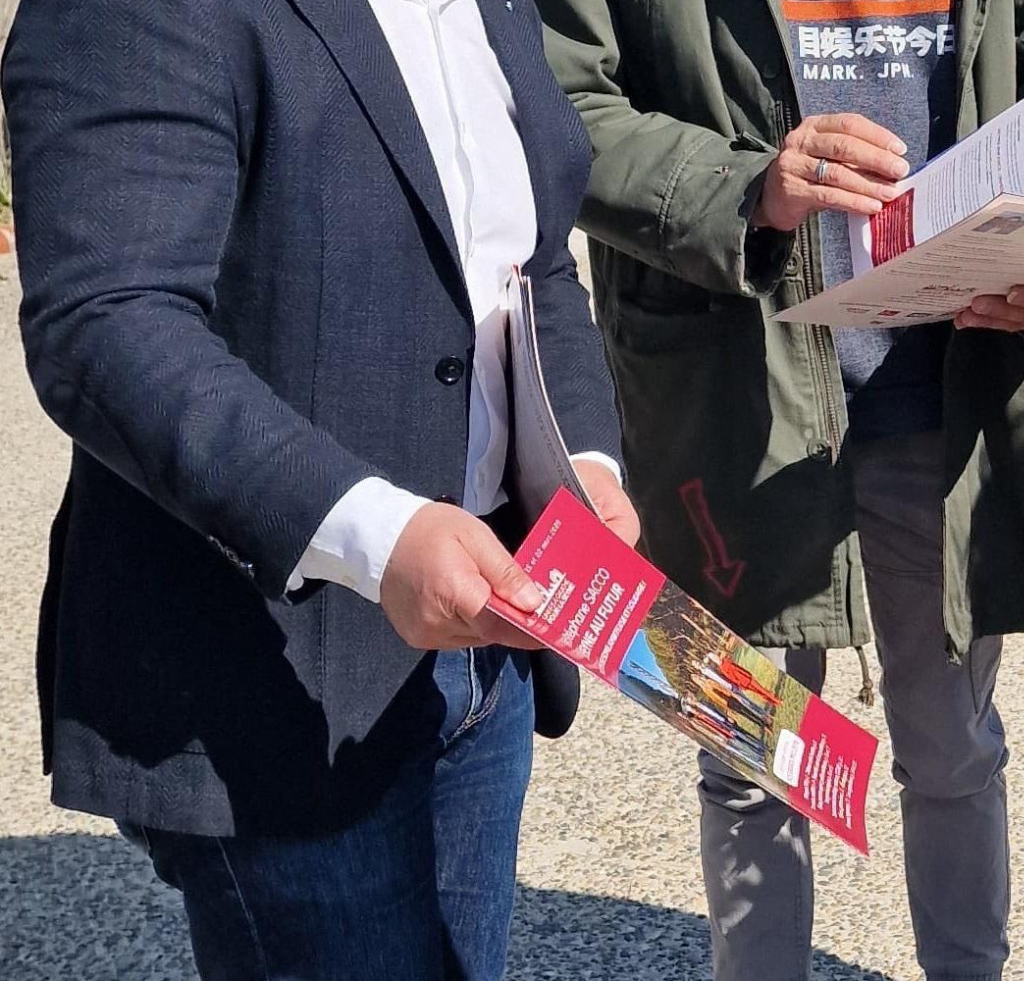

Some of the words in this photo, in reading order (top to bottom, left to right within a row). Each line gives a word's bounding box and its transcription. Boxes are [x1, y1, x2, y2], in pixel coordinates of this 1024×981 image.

[803, 63, 864, 80] MARK.
[877, 62, 915, 79] JPN.
[583, 568, 610, 604] SACCO
[595, 582, 625, 619] FUTUR
[588, 614, 605, 636] AU
